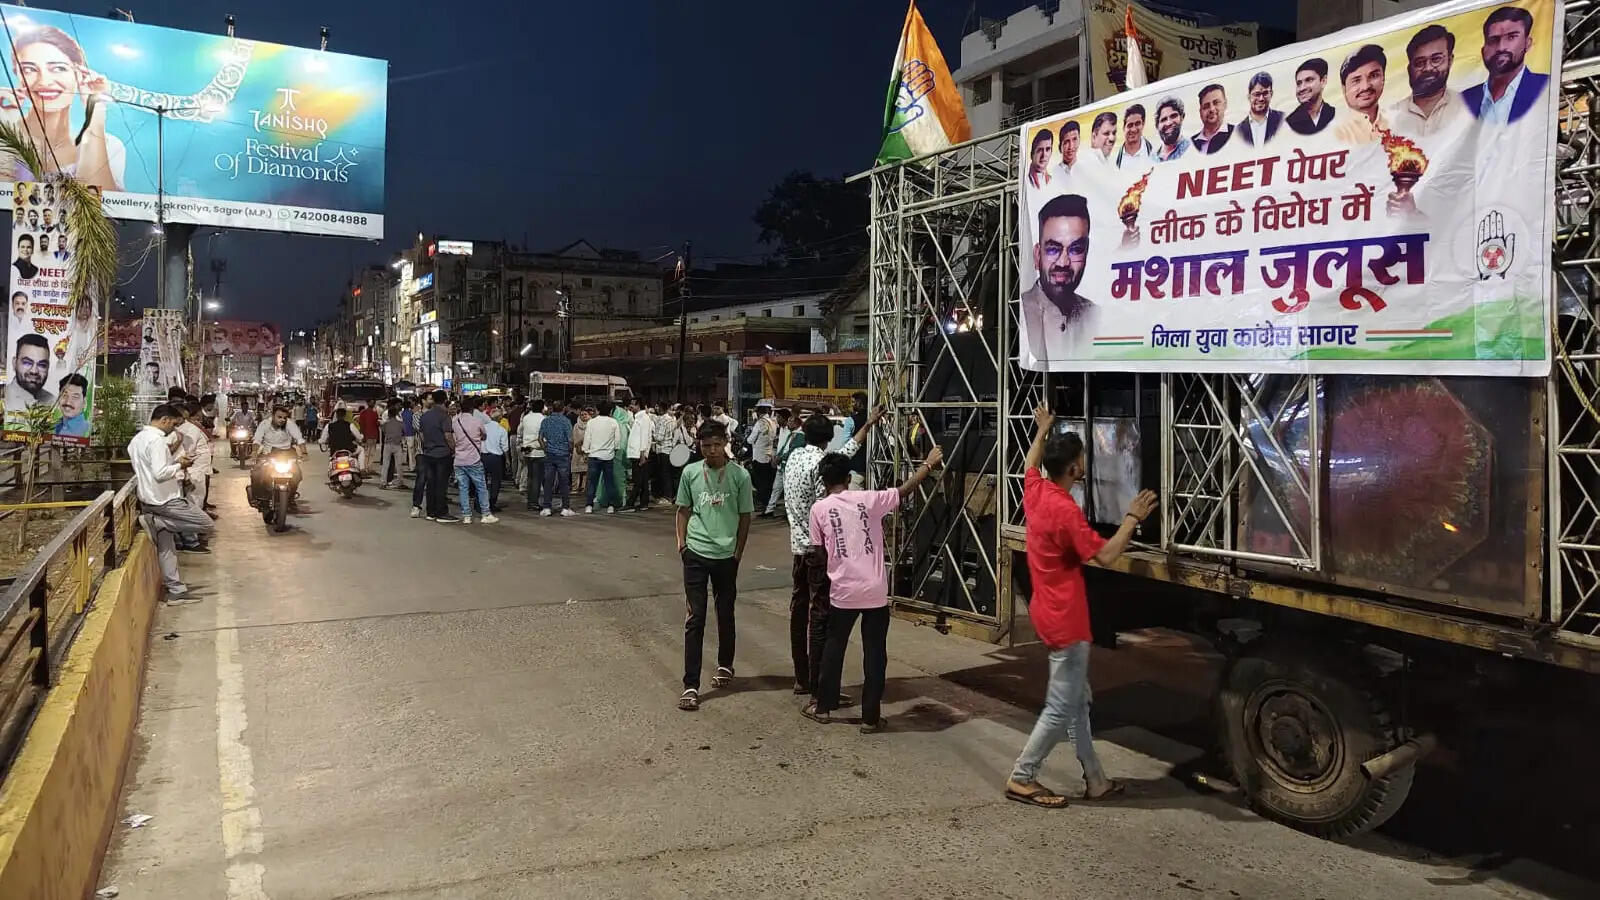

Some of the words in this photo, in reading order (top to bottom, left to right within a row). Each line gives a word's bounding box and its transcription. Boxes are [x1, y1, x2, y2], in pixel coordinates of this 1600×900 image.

[251, 110, 328, 139] TANISHQ
[214, 151, 243, 180] Of
[247, 156, 349, 183] Diamonds
[246, 138, 322, 163] Festival
[1176, 156, 1281, 200] NEET
[1287, 148, 1350, 184] पेपर
[213, 204, 243, 215] Sagar
[293, 210, 368, 226] 7420084988
[1150, 209, 1208, 245] लीक
[1214, 200, 1245, 237] के
[1252, 191, 1332, 234] विरोध
[1341, 183, 1376, 222] में
[39, 267, 67, 278] NEET
[1111, 249, 1250, 301] मशाल
[1260, 232, 1430, 314] जुलूस
[1151, 323, 1192, 349] जिला
[1196, 328, 1228, 354] युवा
[1233, 320, 1293, 349] कांग्रेस
[1297, 324, 1359, 347] सागर
[828, 508, 849, 559] SUPER
[857, 503, 875, 555] SAIYAN
